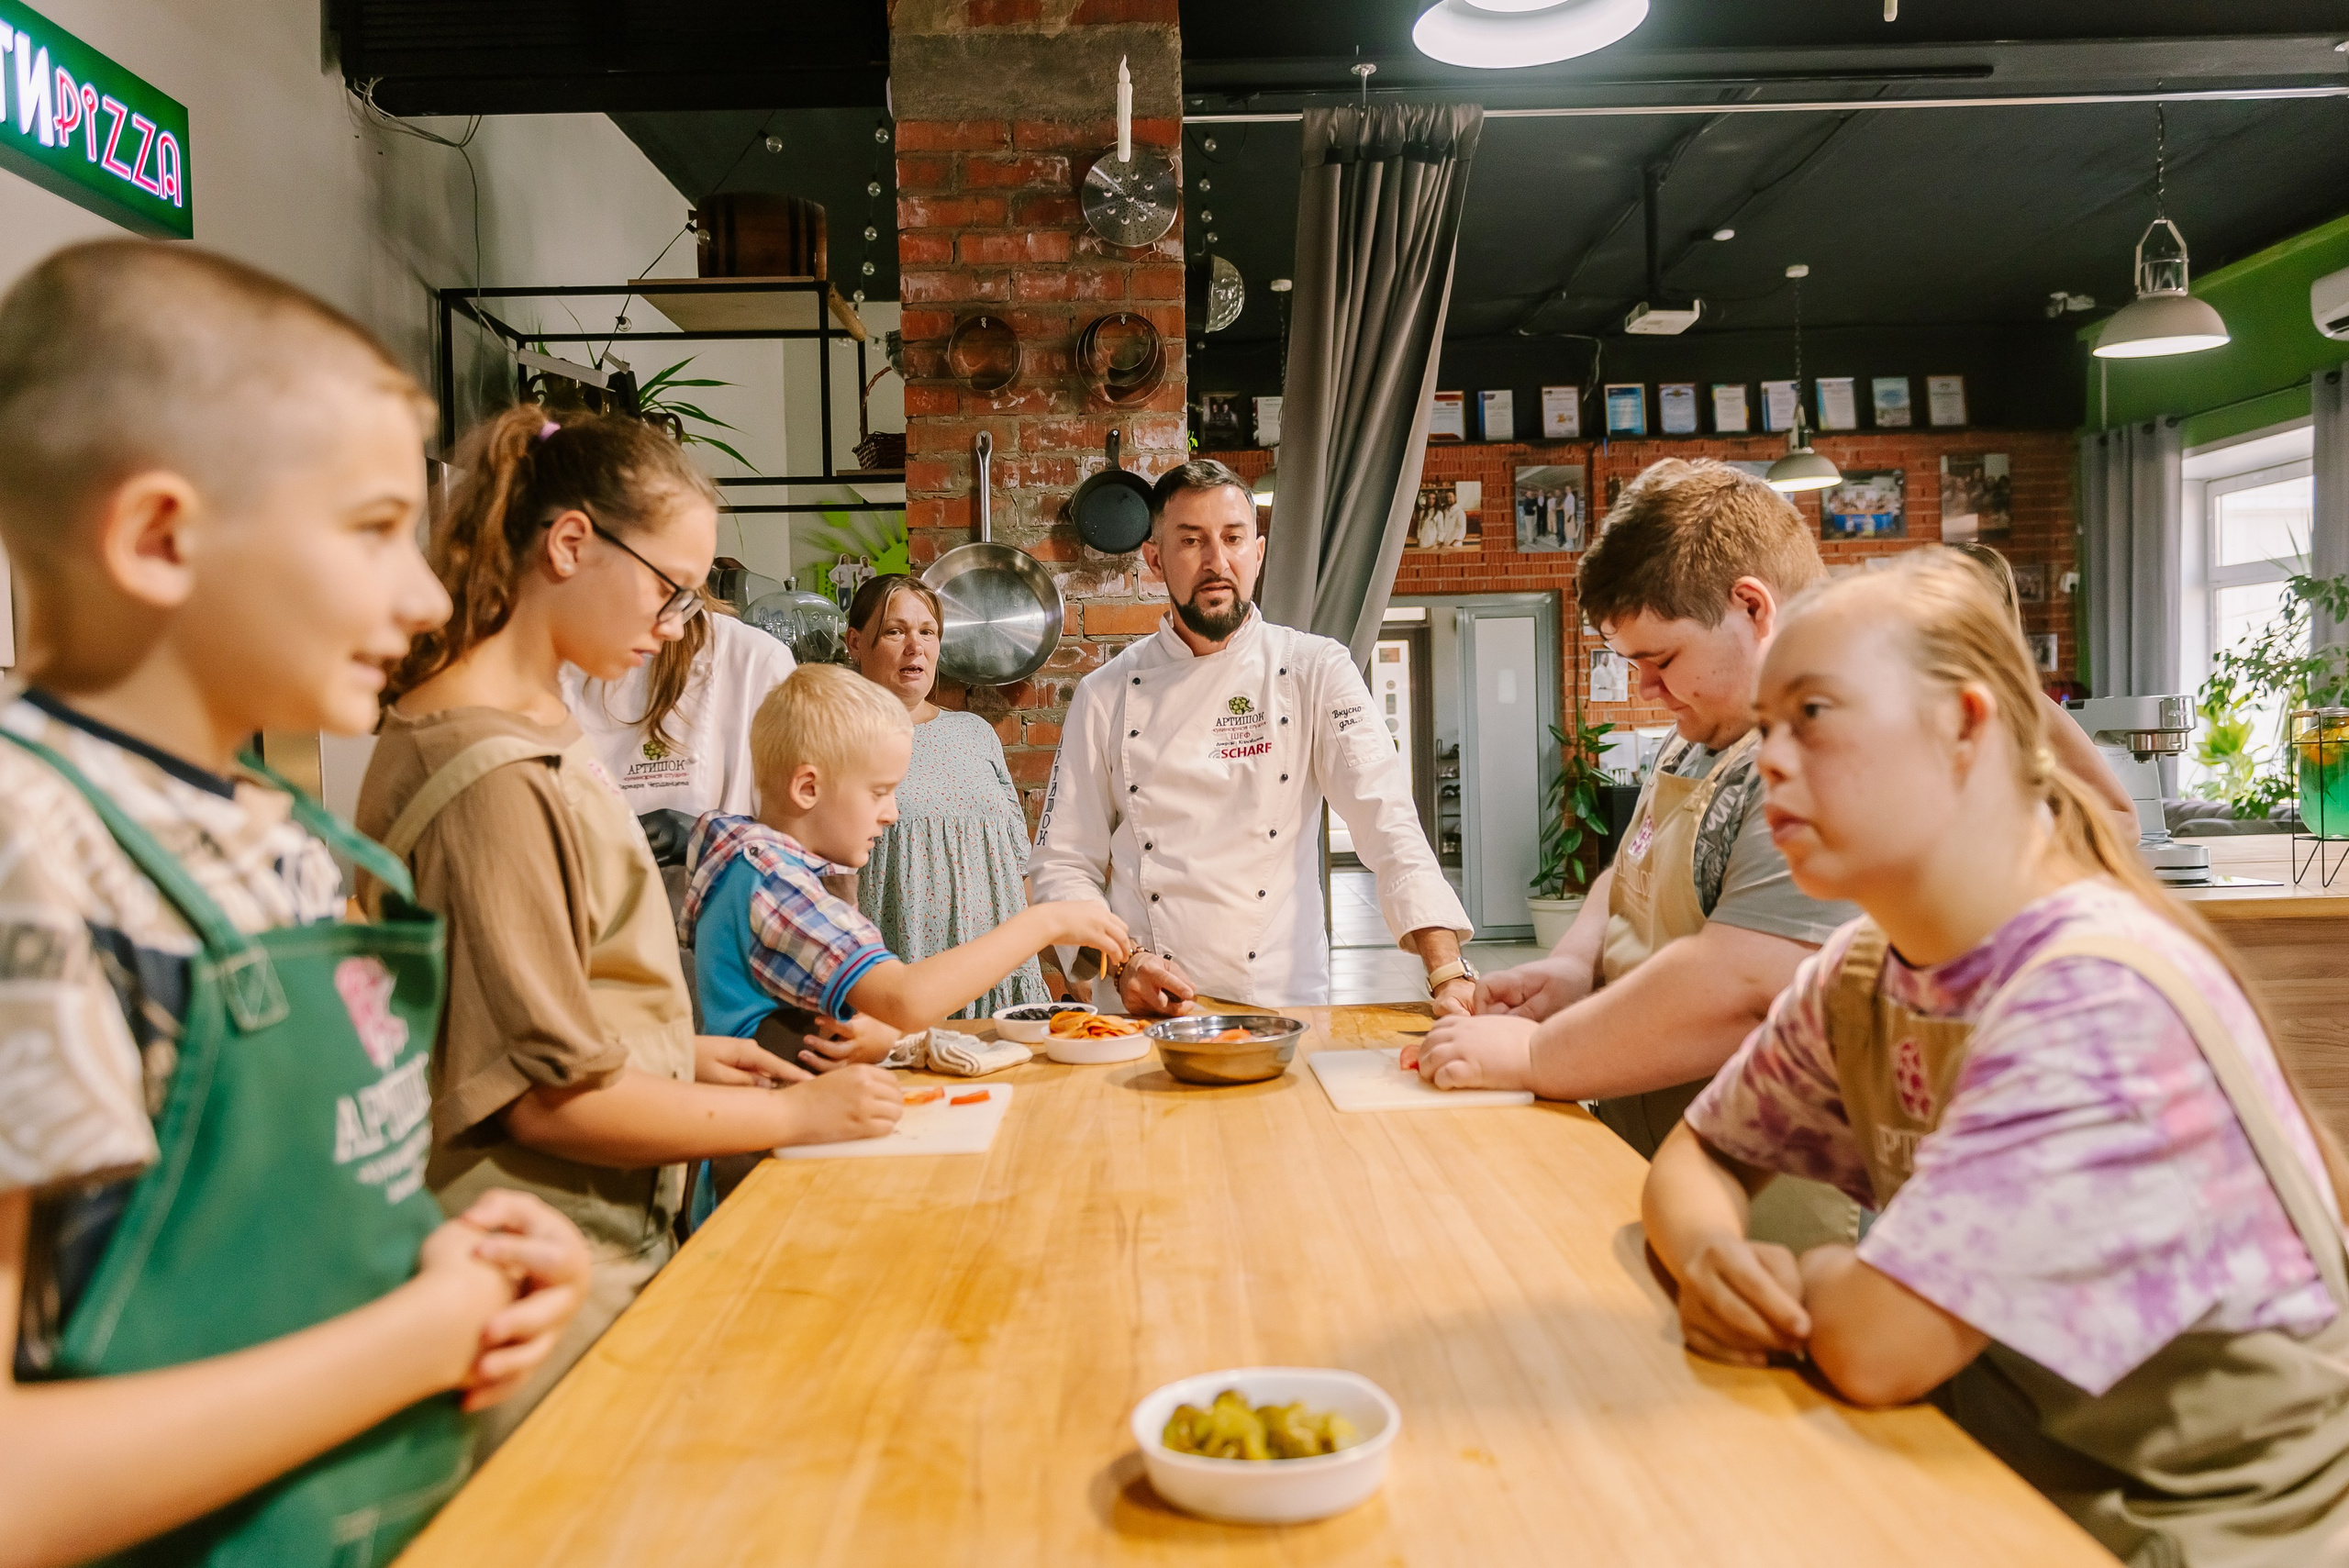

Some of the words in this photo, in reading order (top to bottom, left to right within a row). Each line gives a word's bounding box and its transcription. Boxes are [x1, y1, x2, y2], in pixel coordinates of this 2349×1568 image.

[1216, 712, 1264, 727] АРТИШОК
[1331, 706, 1362, 718] Вкусно
[1221, 742, 1272, 759] SCHARF
[627, 760, 685, 775] АРТИШОК
